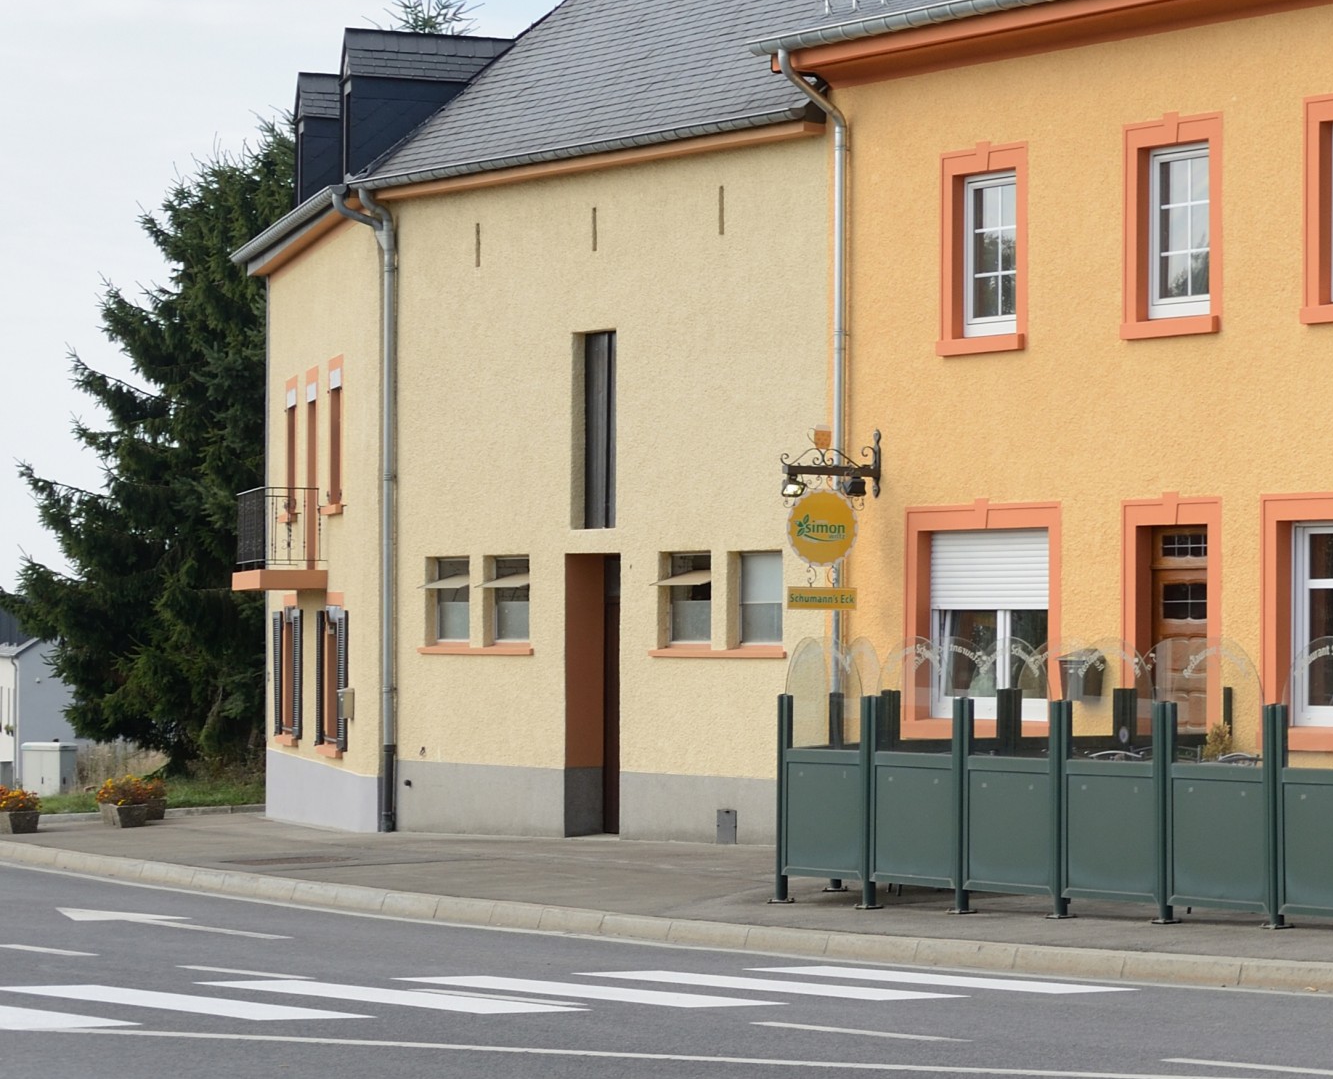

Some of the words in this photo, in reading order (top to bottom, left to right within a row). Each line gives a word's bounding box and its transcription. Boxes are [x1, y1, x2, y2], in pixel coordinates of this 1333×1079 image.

[805, 520, 846, 534] simon
[790, 593, 839, 604] Schumann's
[840, 594, 856, 604] Eck
